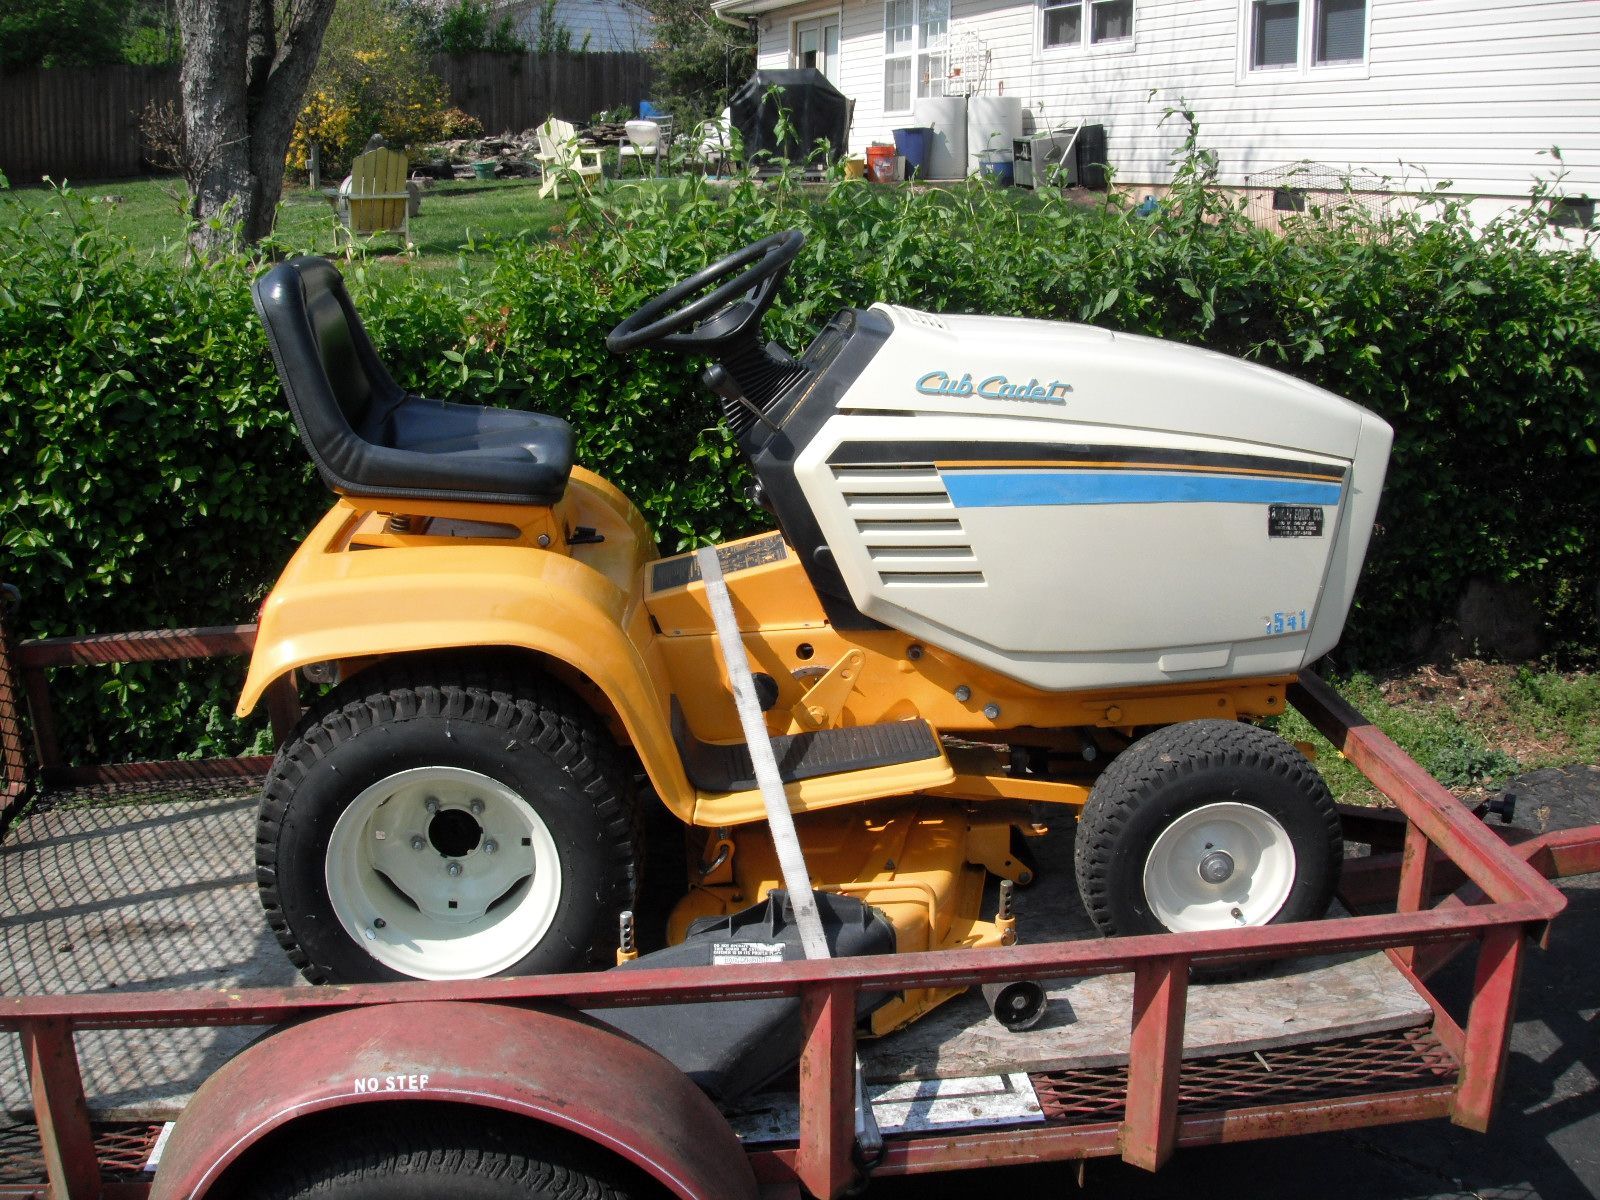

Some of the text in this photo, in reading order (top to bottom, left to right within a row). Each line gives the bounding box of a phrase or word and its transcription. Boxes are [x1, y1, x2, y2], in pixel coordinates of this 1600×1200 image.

[916, 371, 1073, 406] Cub Cadet
[354, 1074, 429, 1094] NO STEP
